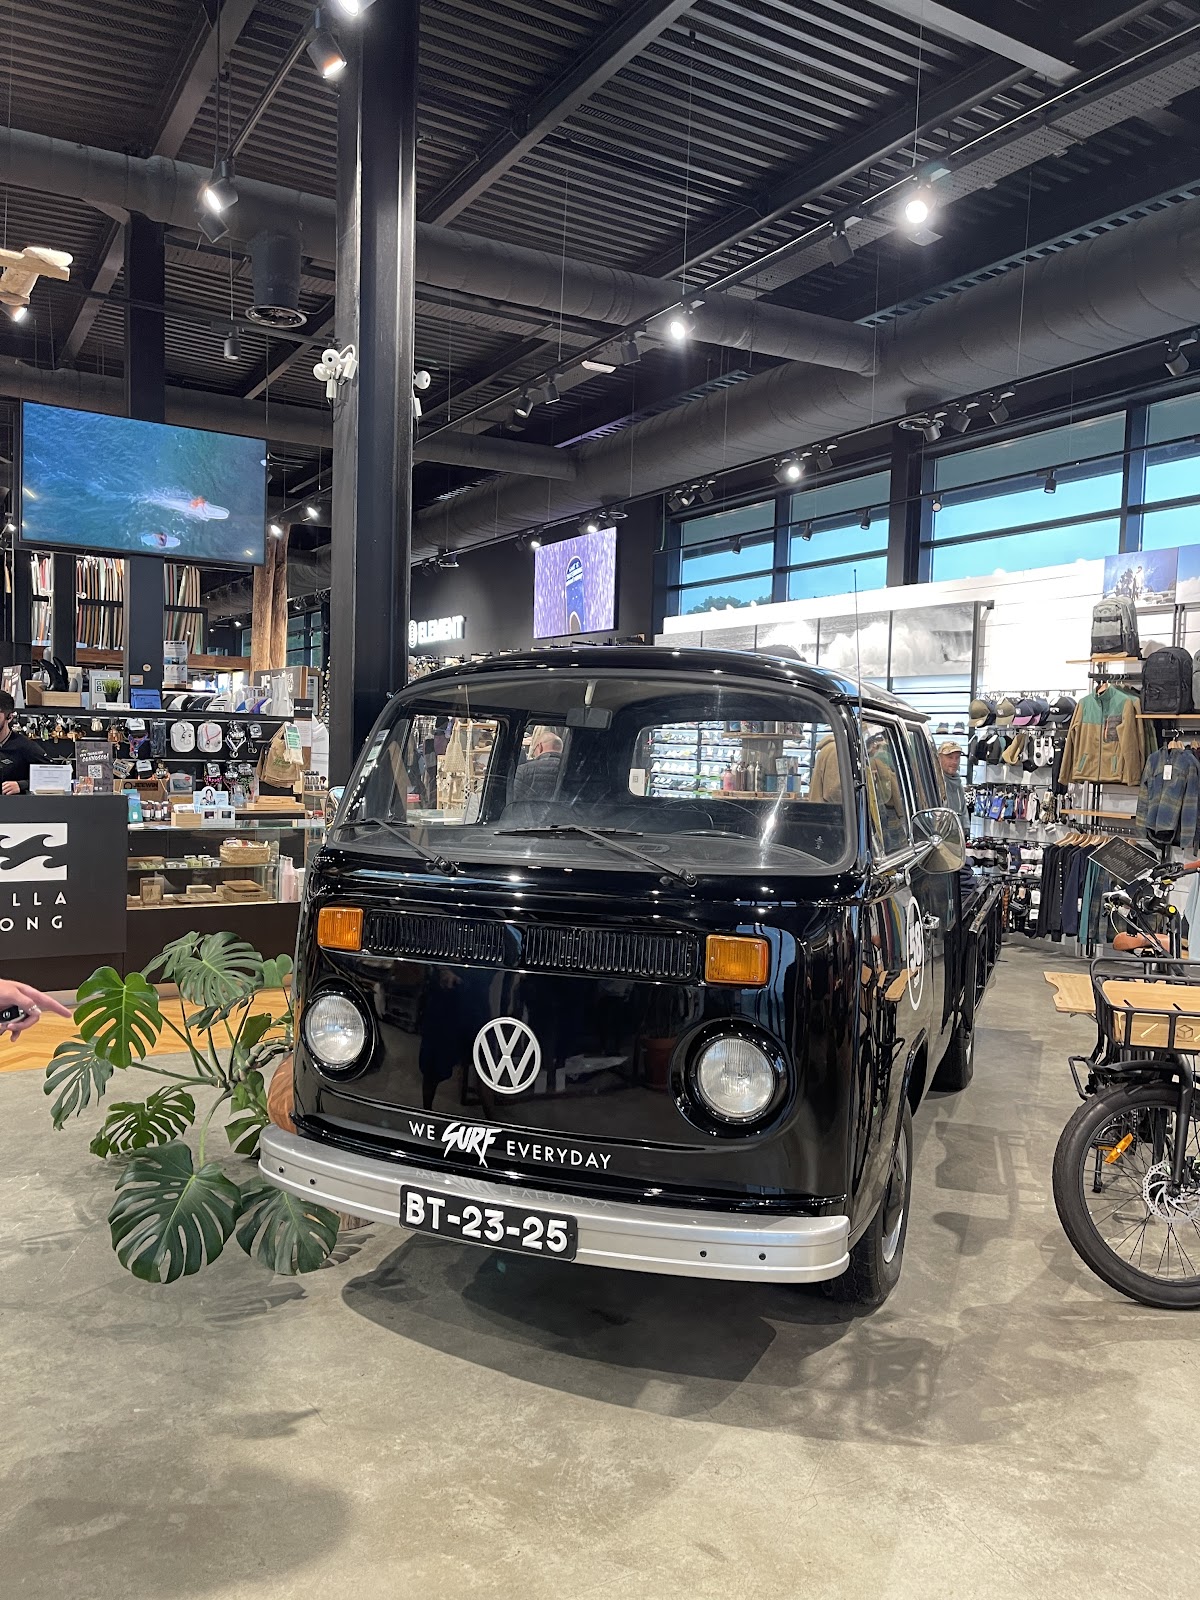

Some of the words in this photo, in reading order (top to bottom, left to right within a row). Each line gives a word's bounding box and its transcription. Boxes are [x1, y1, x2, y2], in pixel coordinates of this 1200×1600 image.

[417, 615, 465, 645] ELEMENT
[477, 1021, 538, 1089] VW
[408, 1120, 435, 1141] WE
[441, 1122, 502, 1168] SURF
[506, 1140, 611, 1170] EVERYDAY
[405, 1191, 568, 1253] BT-23-25
